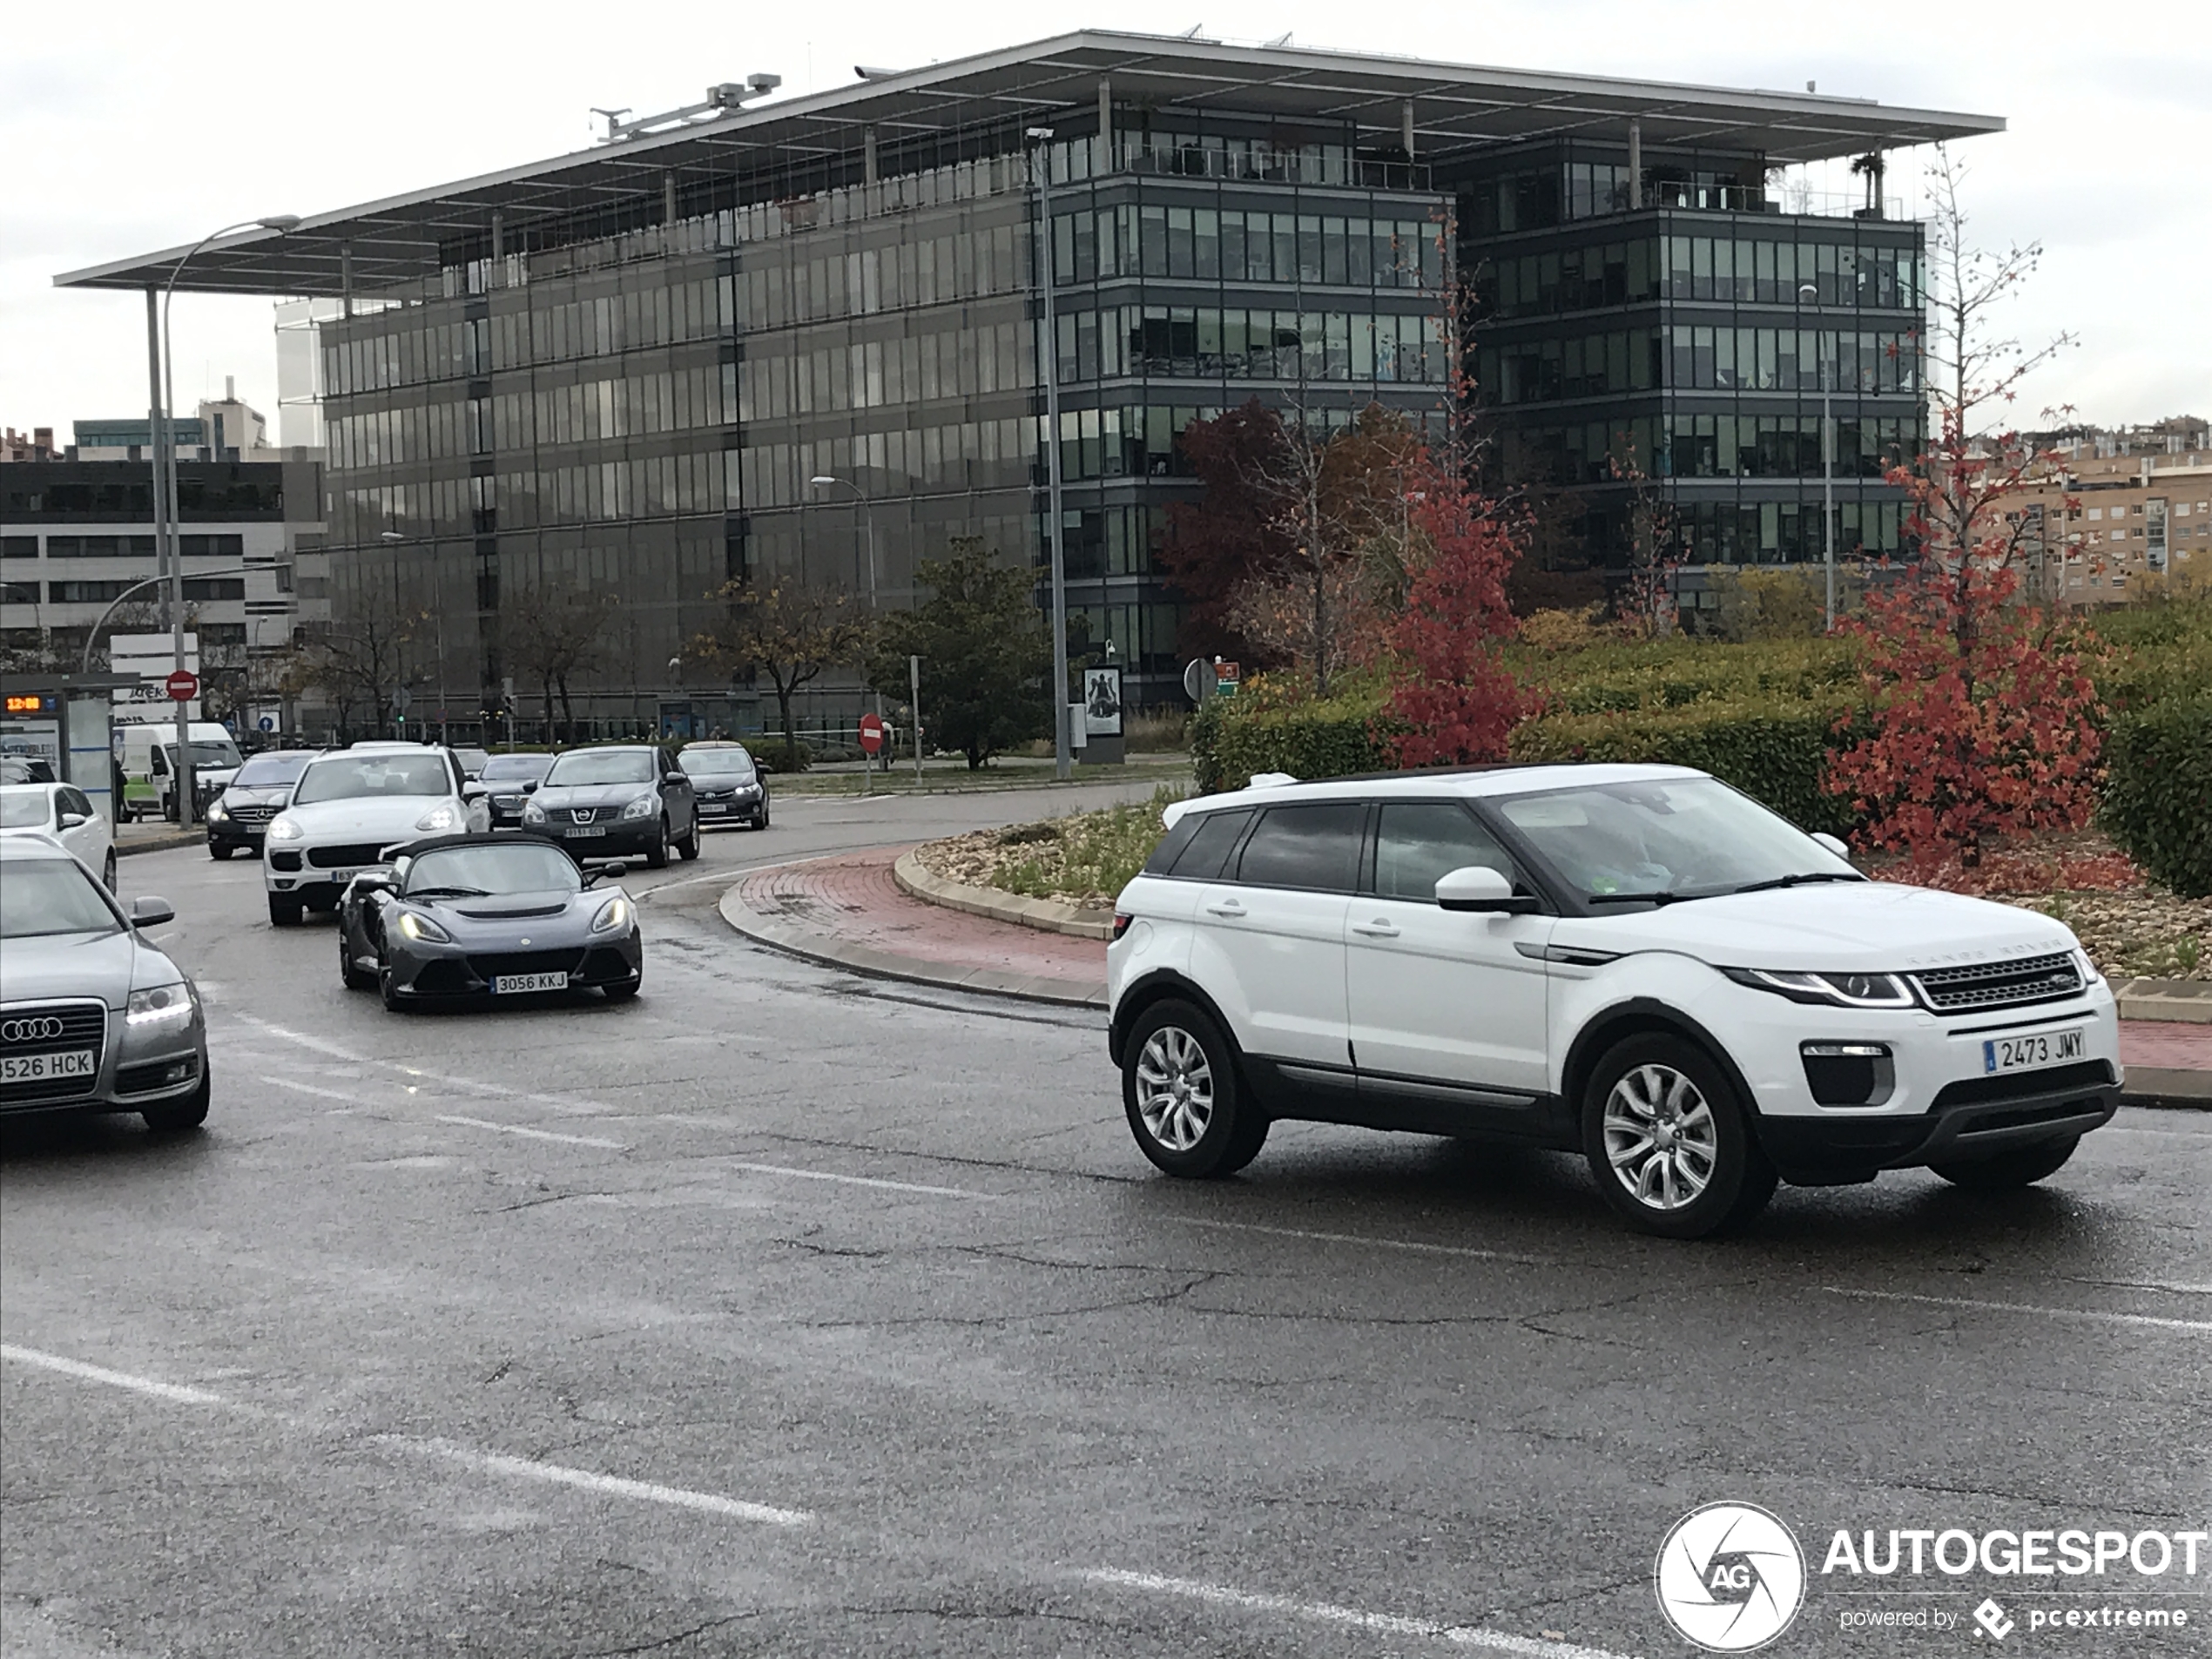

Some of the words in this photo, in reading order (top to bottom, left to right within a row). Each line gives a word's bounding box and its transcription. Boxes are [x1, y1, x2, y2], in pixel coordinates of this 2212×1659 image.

[1905, 951, 1986, 965] RANGE
[1998, 939, 2063, 954] ROVER
[500, 976, 535, 991] 3056
[539, 974, 564, 988] KKJ
[2001, 1037, 2048, 1066] 2473
[2055, 1032, 2080, 1058] JMY
[0, 1058, 44, 1078] 526
[51, 1054, 89, 1074] HCK
